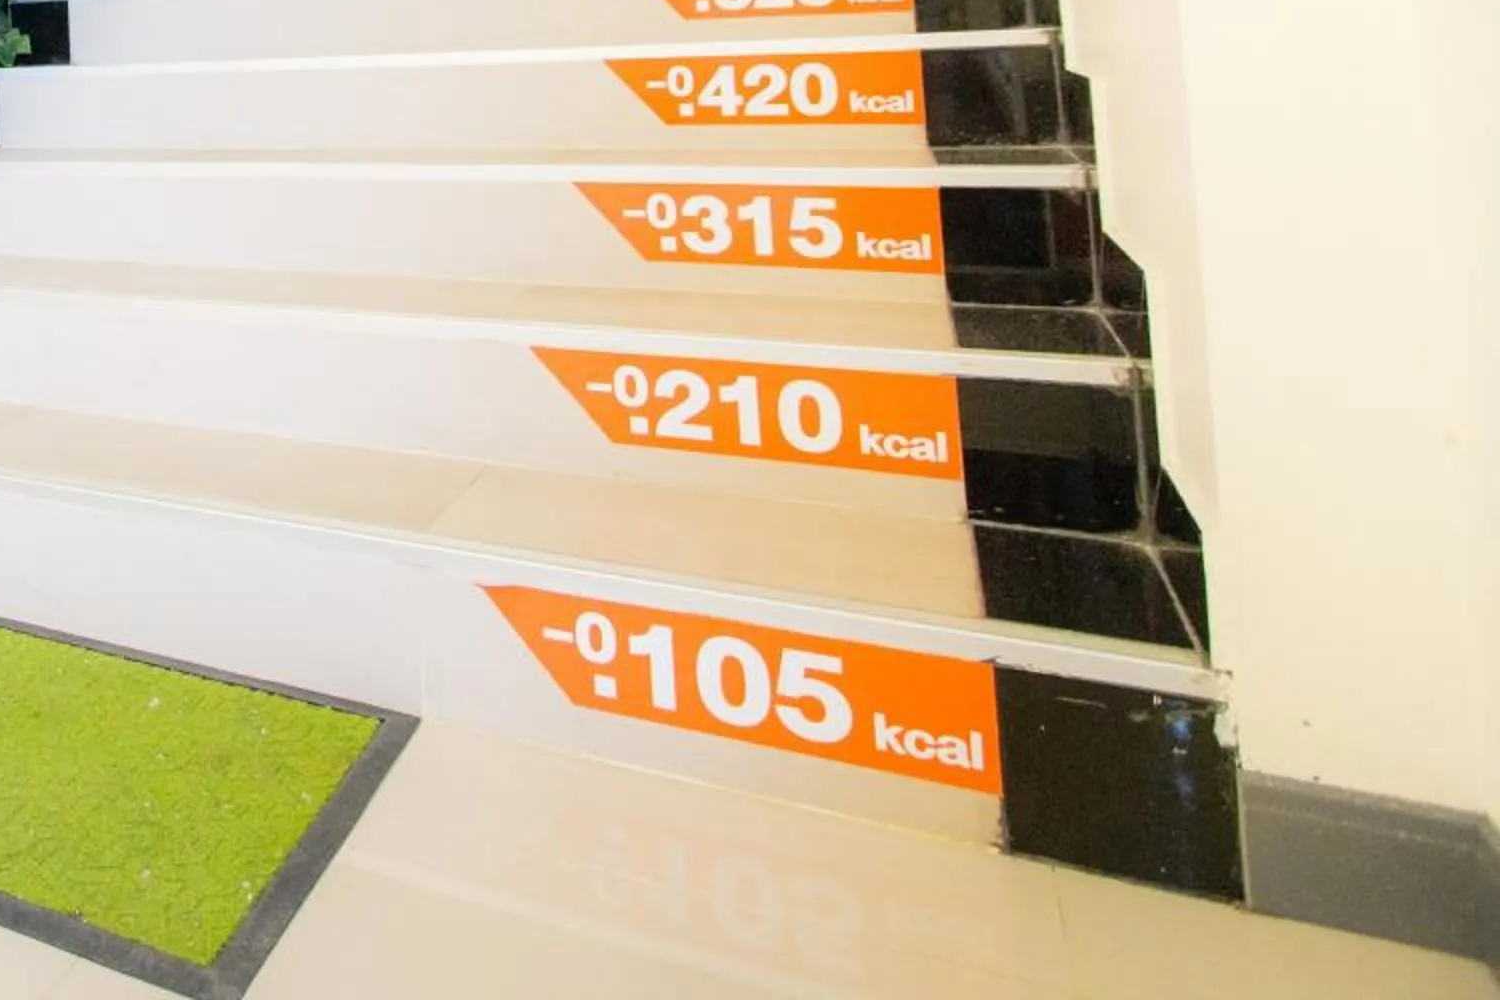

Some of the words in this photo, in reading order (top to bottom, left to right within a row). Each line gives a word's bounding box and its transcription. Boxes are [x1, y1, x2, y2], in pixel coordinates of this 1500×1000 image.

[849, 90, 915, 114] kcal
[856, 231, 932, 262] kcal
[859, 424, 949, 464] kcal
[873, 712, 984, 772] kcal
